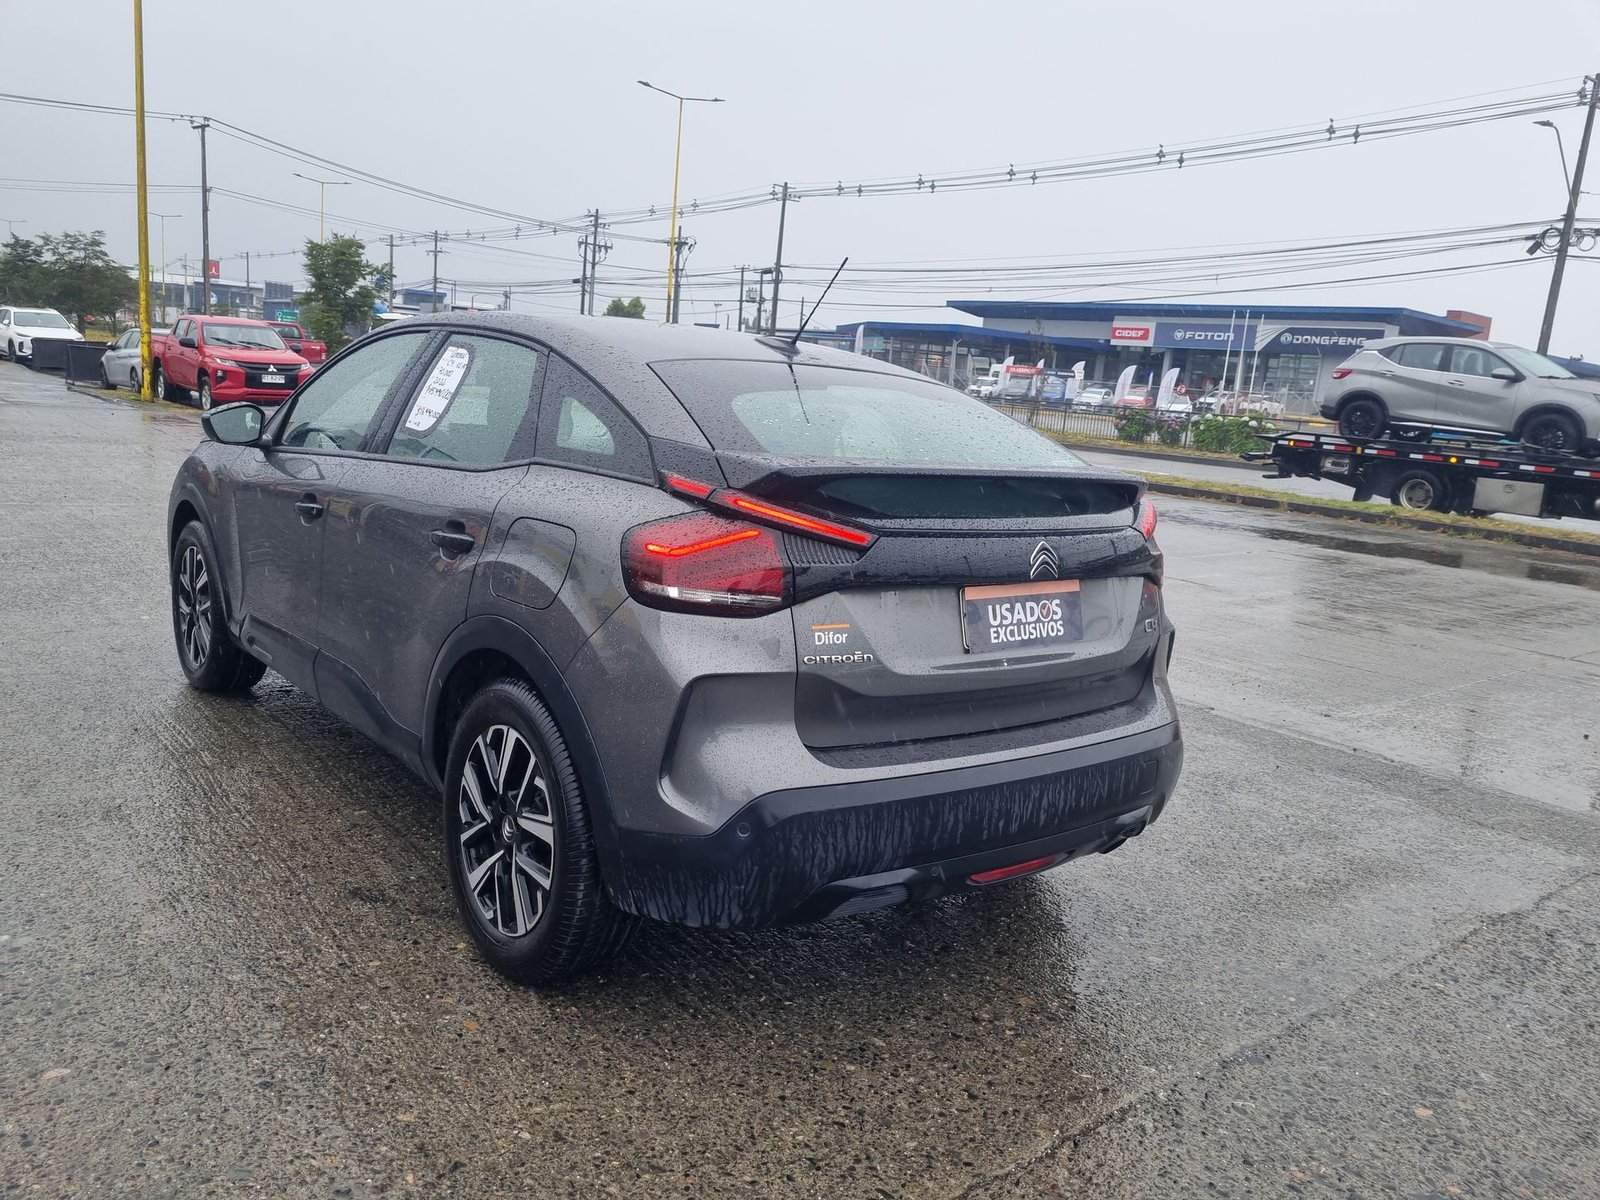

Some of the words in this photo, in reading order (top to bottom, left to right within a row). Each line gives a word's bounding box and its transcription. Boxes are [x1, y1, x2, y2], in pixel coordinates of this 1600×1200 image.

[1114, 329, 1146, 339] CIDEF
[1292, 335, 1367, 346] DONGFENG
[987, 598, 1063, 626] USADOS
[814, 631, 848, 645] Difor
[989, 620, 1065, 644] EXCLUSIVOS
